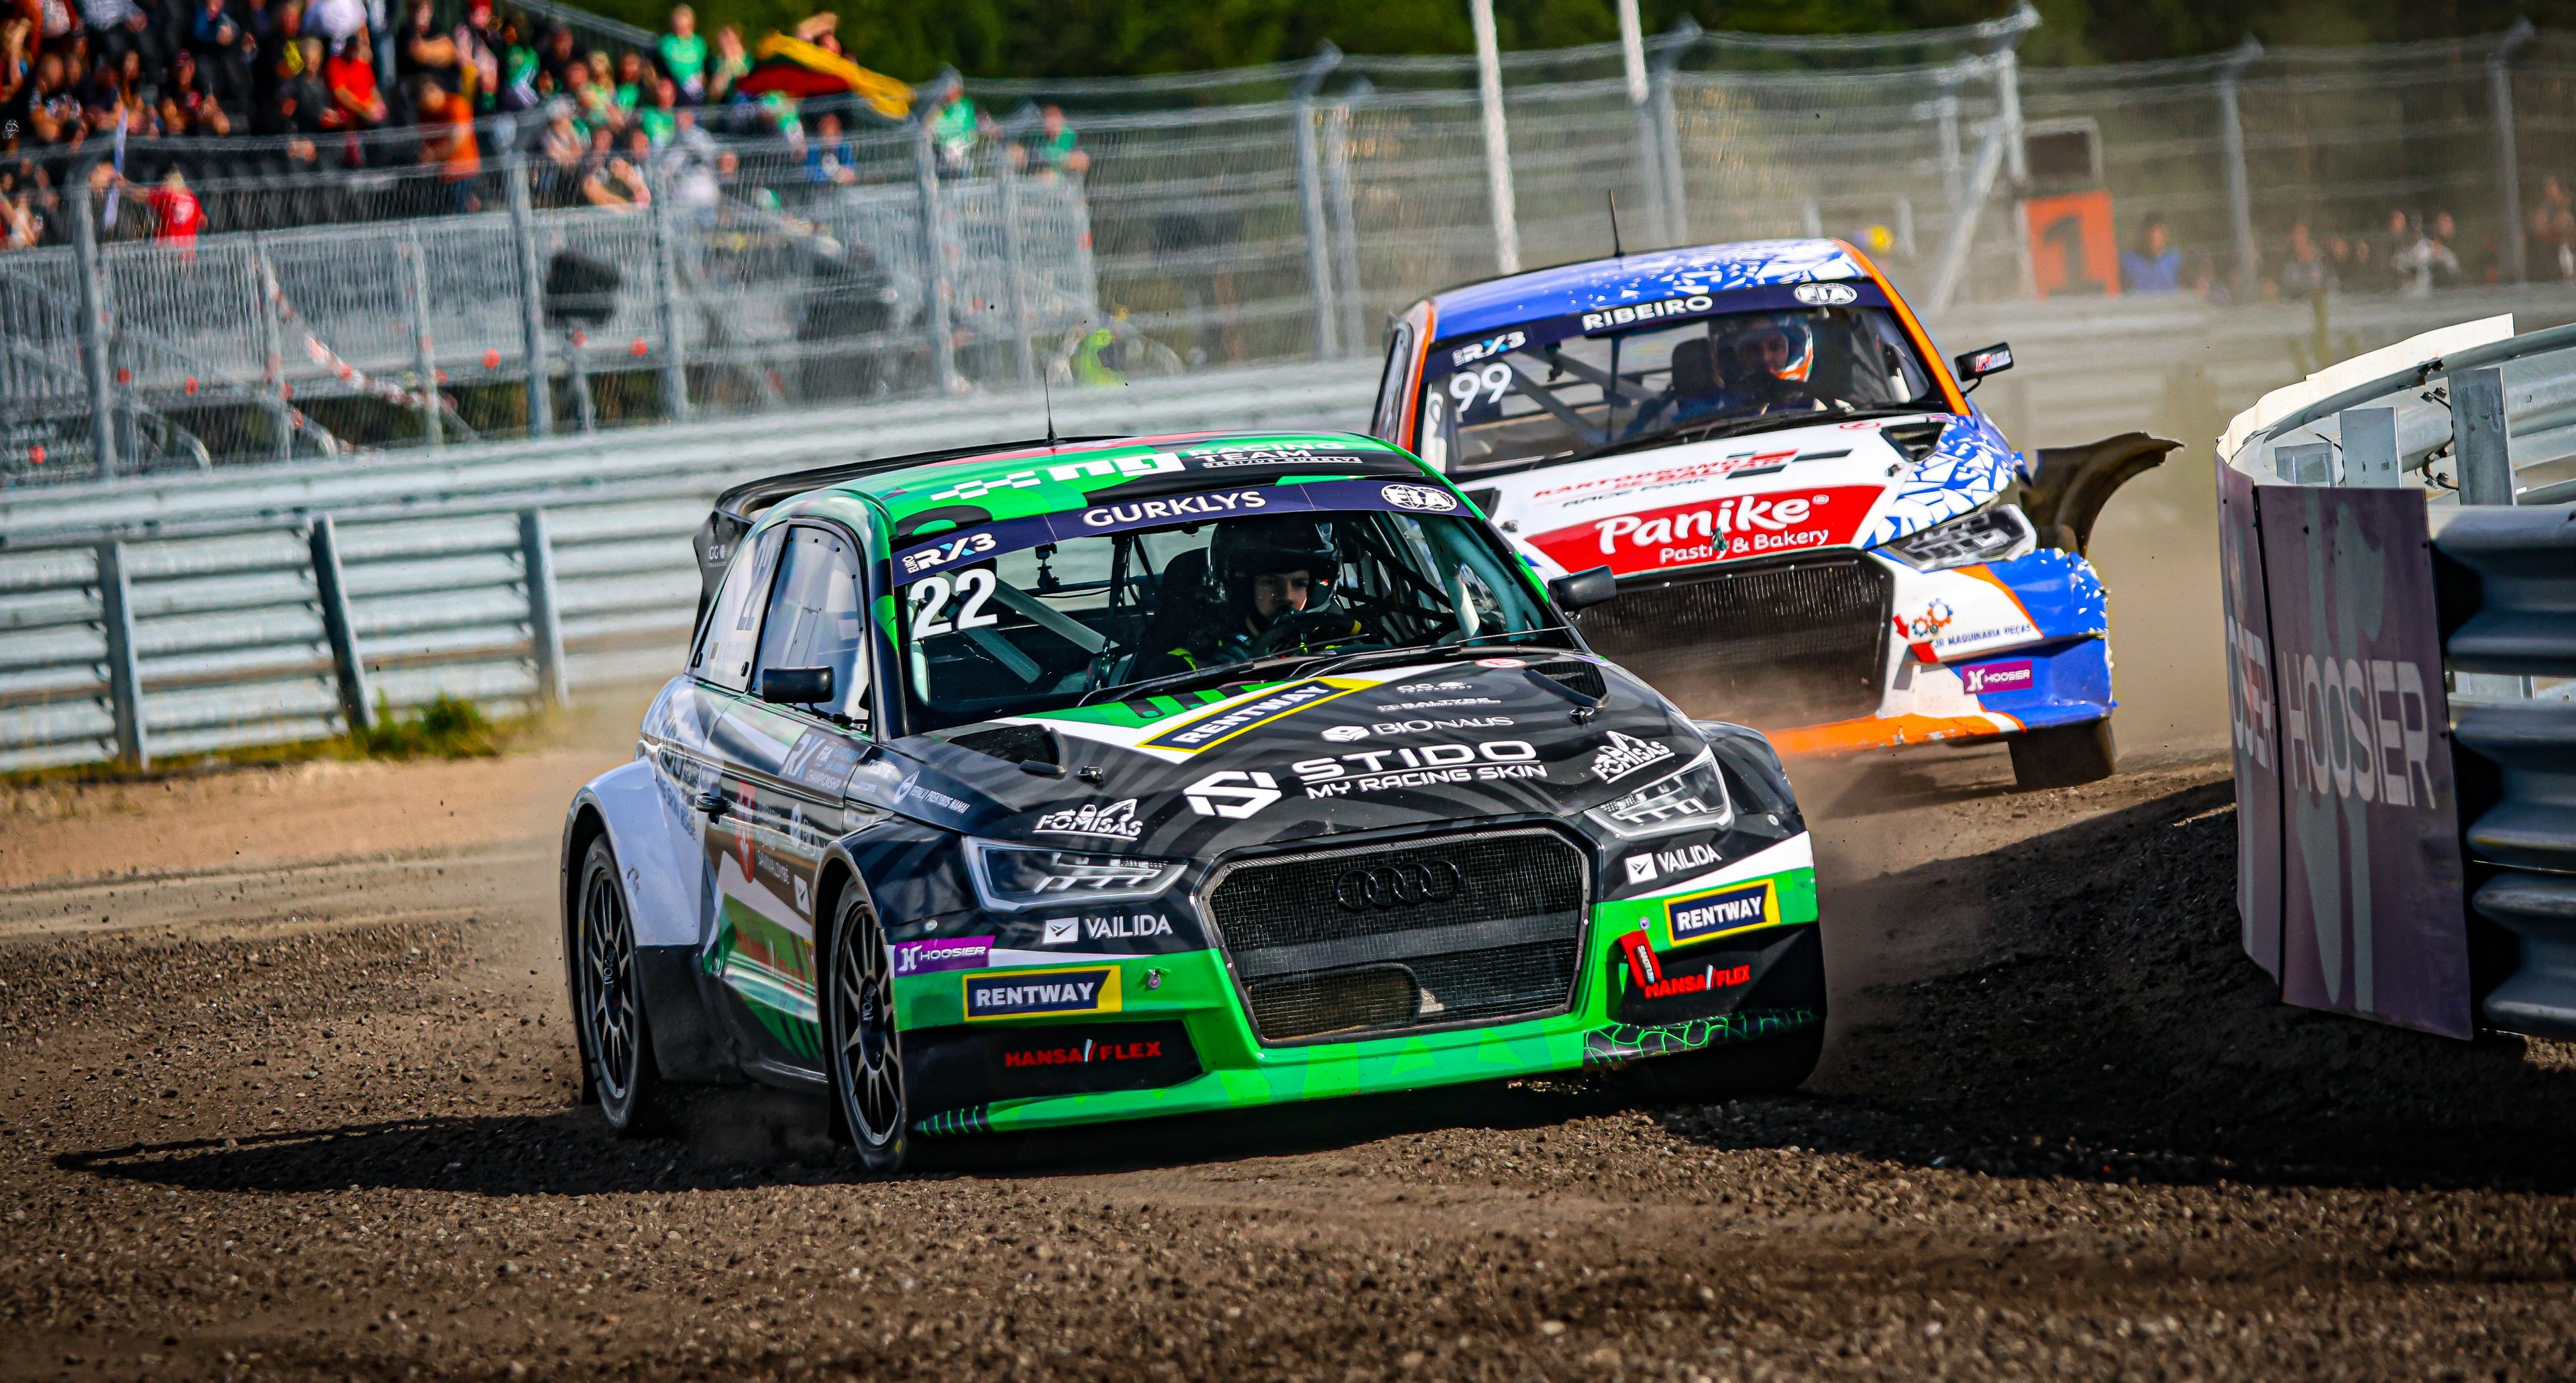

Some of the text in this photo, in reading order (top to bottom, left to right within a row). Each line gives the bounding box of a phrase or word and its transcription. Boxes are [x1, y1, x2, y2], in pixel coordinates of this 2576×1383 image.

[2042, 212, 2106, 296] 1
[1797, 285, 1855, 302] FIA
[1582, 295, 1713, 331] RIBEIRO
[1462, 331, 1526, 363] RX3
[1449, 362, 1512, 413] 99
[1186, 443, 1346, 456] RACING
[1195, 450, 1312, 462] TEAM
[1656, 457, 1784, 482] BALTAR
[1083, 491, 1267, 527] GURKLYS
[1387, 486, 1455, 509] FIA
[1595, 495, 1811, 555] Panike
[902, 533, 997, 574] EURO RX3
[1660, 529, 1829, 564] Pastry & Bakery
[908, 568, 998, 641] 22
[1984, 669, 2031, 683] HOOSIER
[1172, 686, 1330, 743] RENTWAY
[1372, 716, 1515, 735] BIONALIS
[2283, 650, 2435, 809] HOOSIER
[1292, 740, 1537, 781] STIDO
[1590, 741, 1670, 780] FOMISAS
[1305, 764, 1548, 800] MY RACING SKIN
[949, 799, 971, 814] NAMAI
[1035, 813, 1143, 836] FOMISAS
[1656, 843, 1723, 873] VAILIDA
[1084, 915, 1173, 940] VAILIDA
[1676, 896, 1762, 932] RENTWAY
[920, 946, 987, 961] HOOSIER
[976, 982, 1095, 1007] RENTWAY
